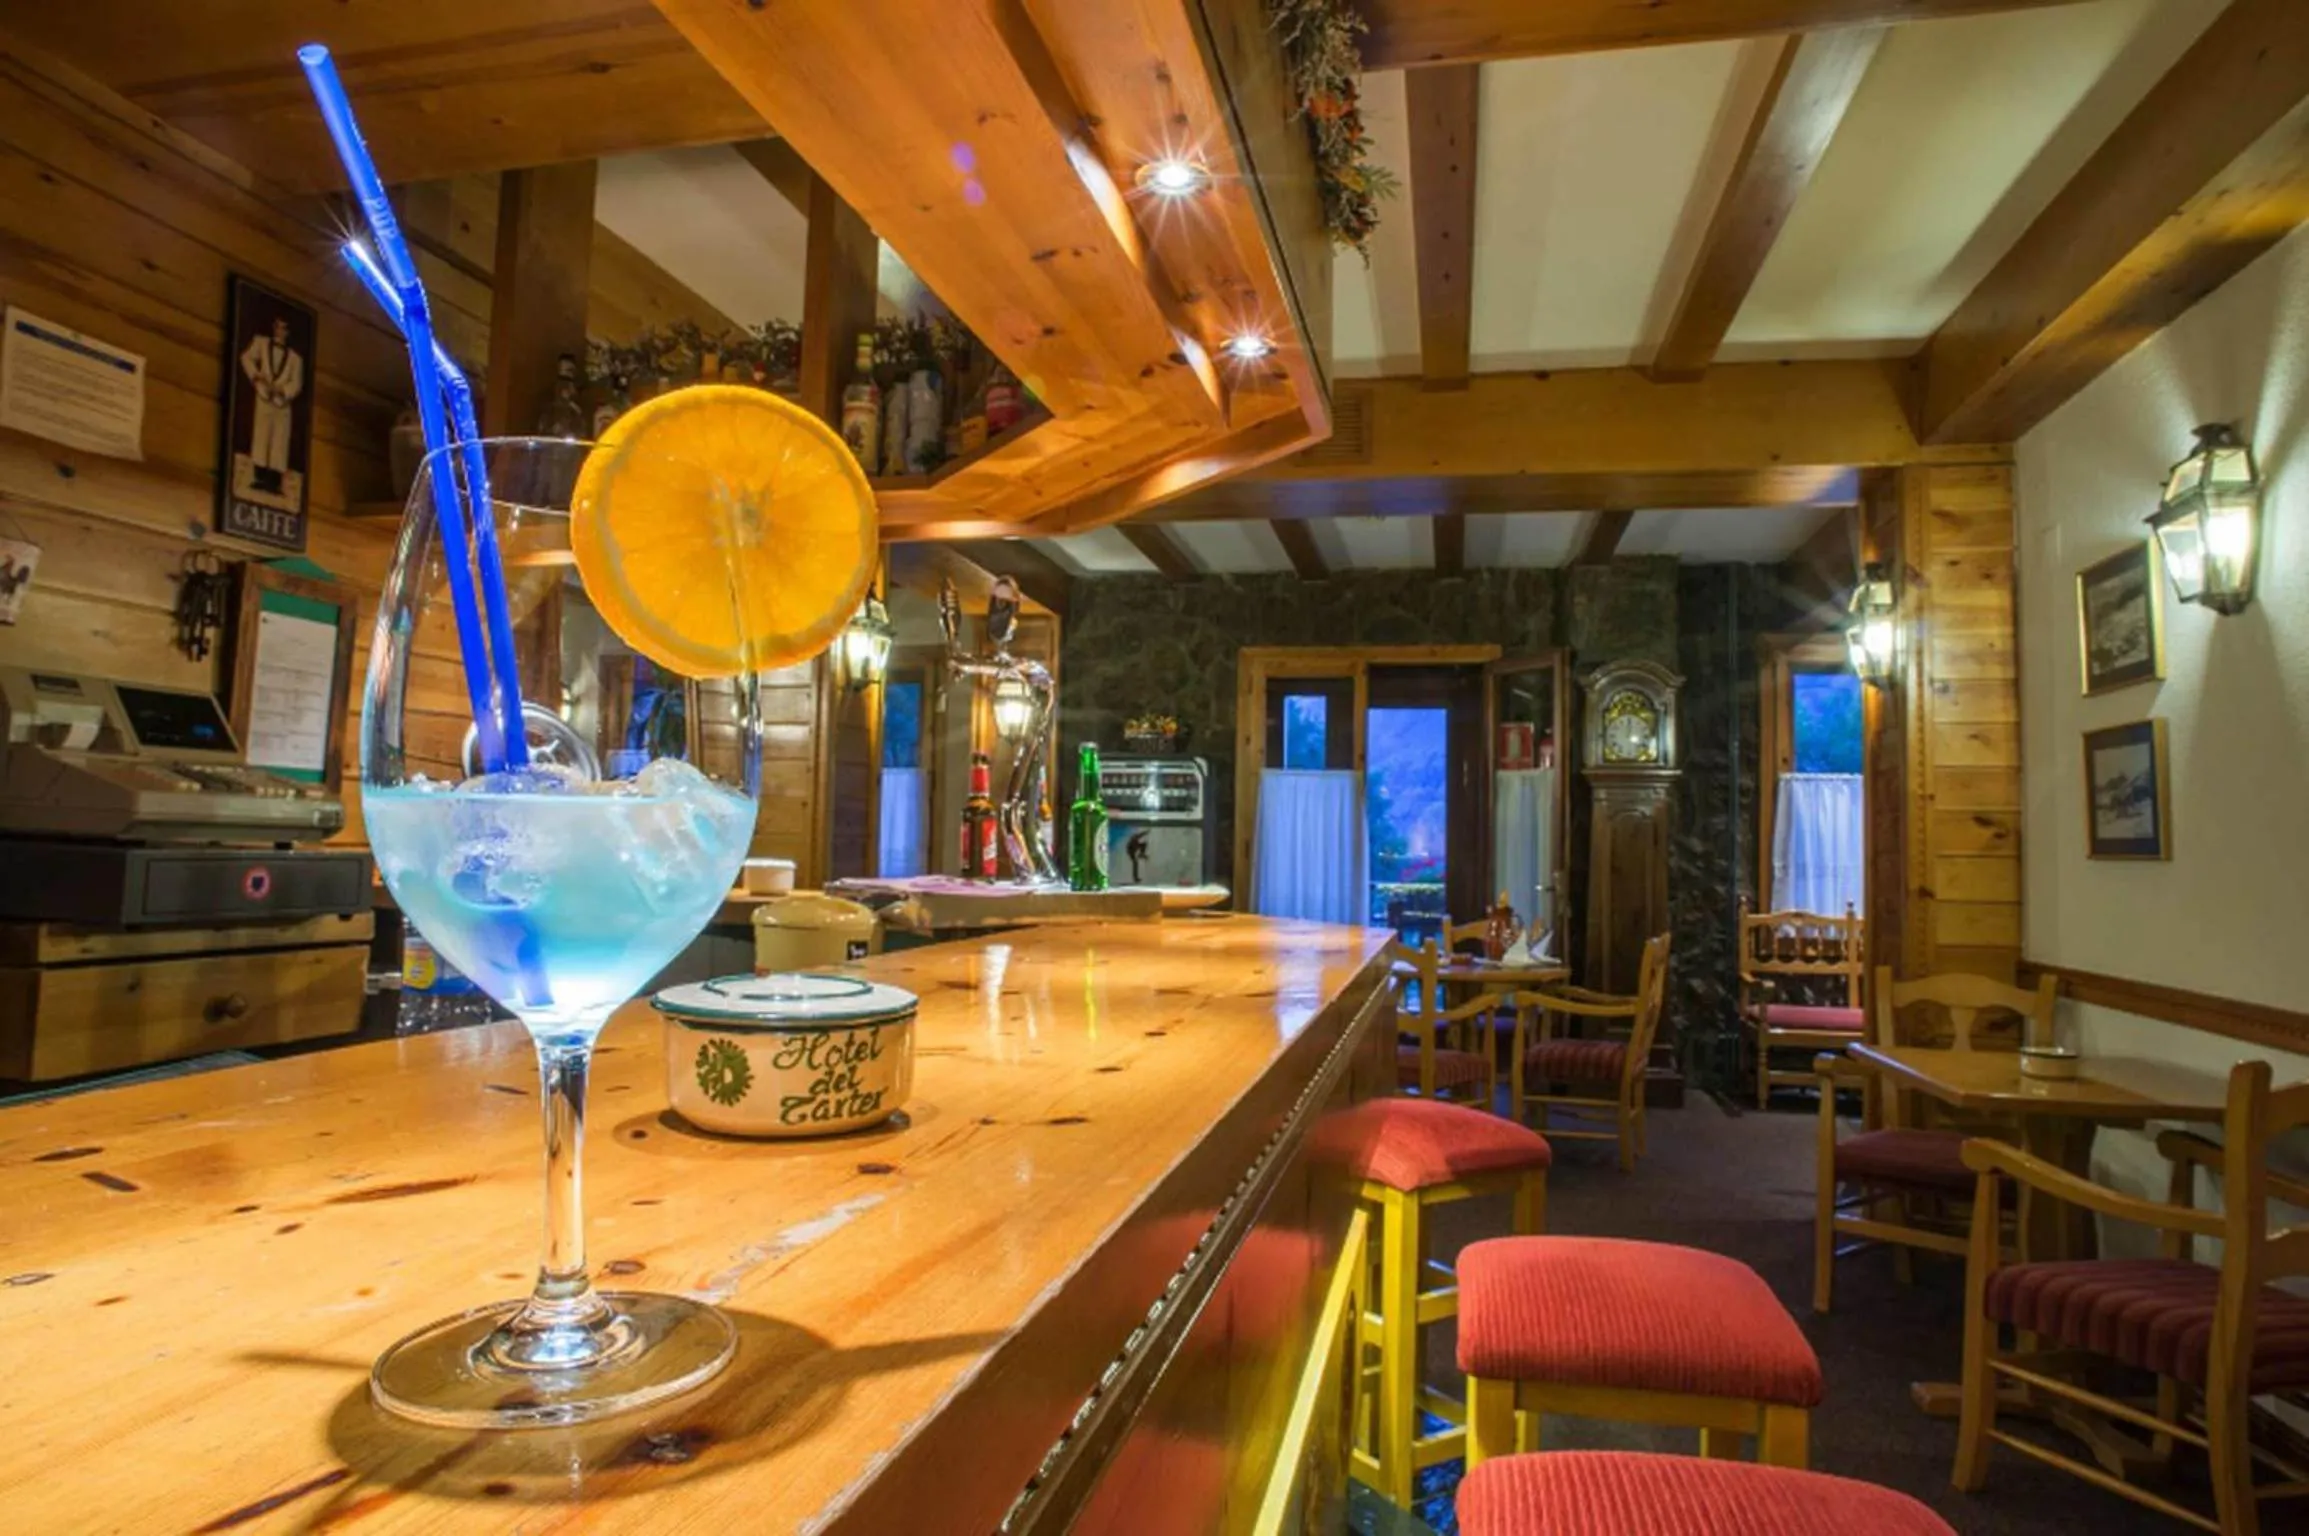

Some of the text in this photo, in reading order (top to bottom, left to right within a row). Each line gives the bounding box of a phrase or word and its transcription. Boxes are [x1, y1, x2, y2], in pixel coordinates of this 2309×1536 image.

[772, 1024, 885, 1071] Hotel
[808, 1064, 864, 1095] del
[780, 1086, 890, 1125] Tarter
